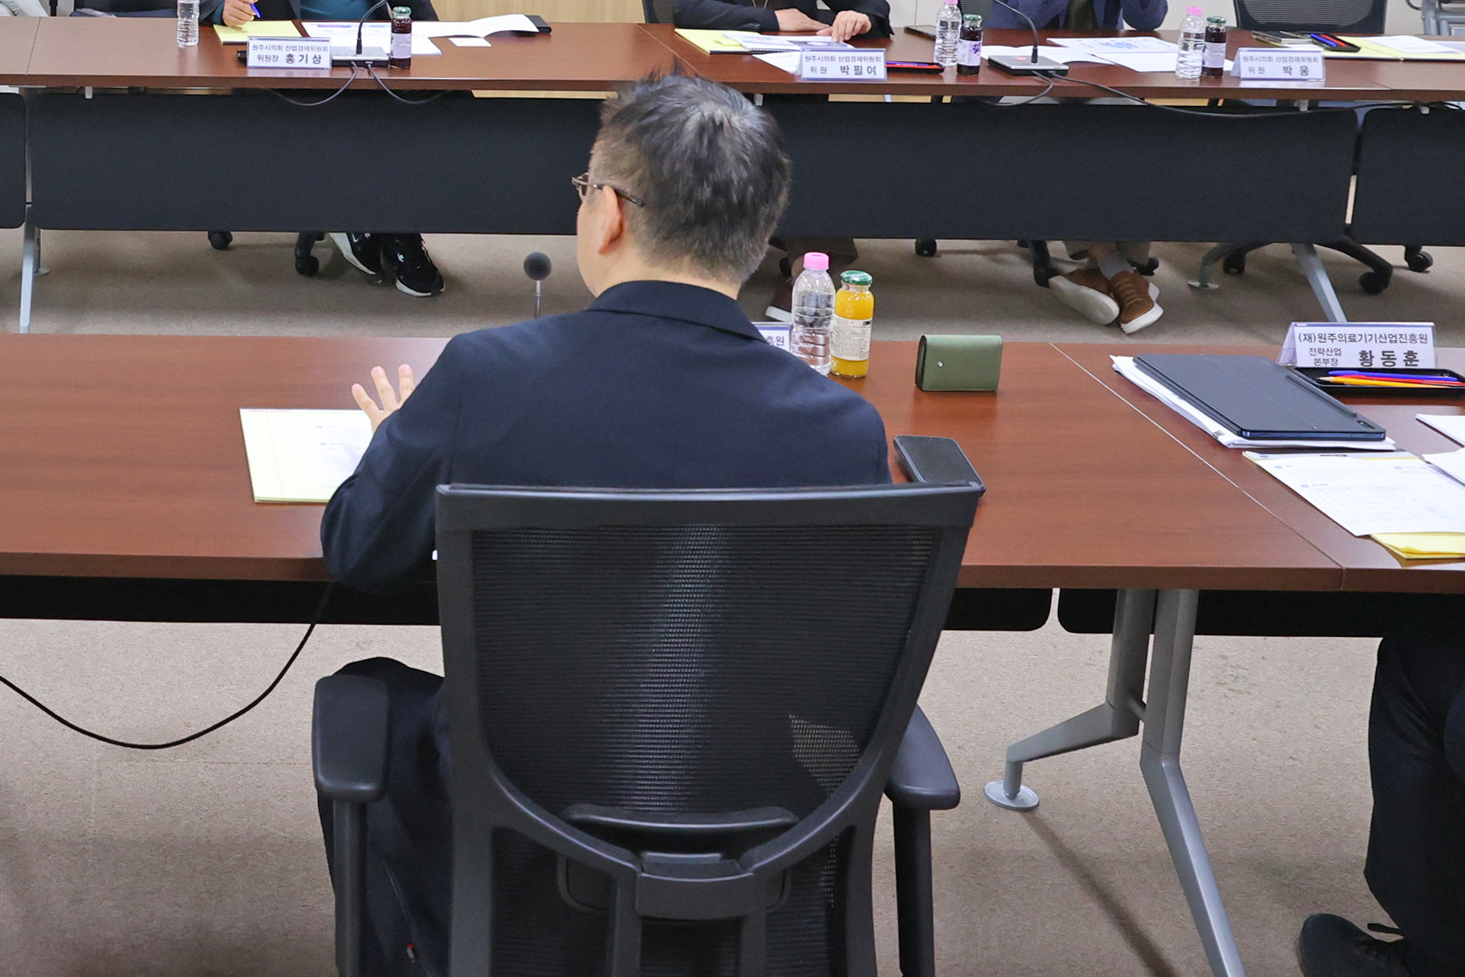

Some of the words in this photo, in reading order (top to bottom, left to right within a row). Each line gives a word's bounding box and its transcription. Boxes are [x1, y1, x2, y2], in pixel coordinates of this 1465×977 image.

[285, 53, 322, 64] 홍기상
[1298, 332, 1428, 344] (재)원주의료기기산업진흥원
[1308, 347, 1342, 357] 전략산업
[1359, 349, 1420, 367] 황동훈
[1313, 357, 1339, 367] 본부장
